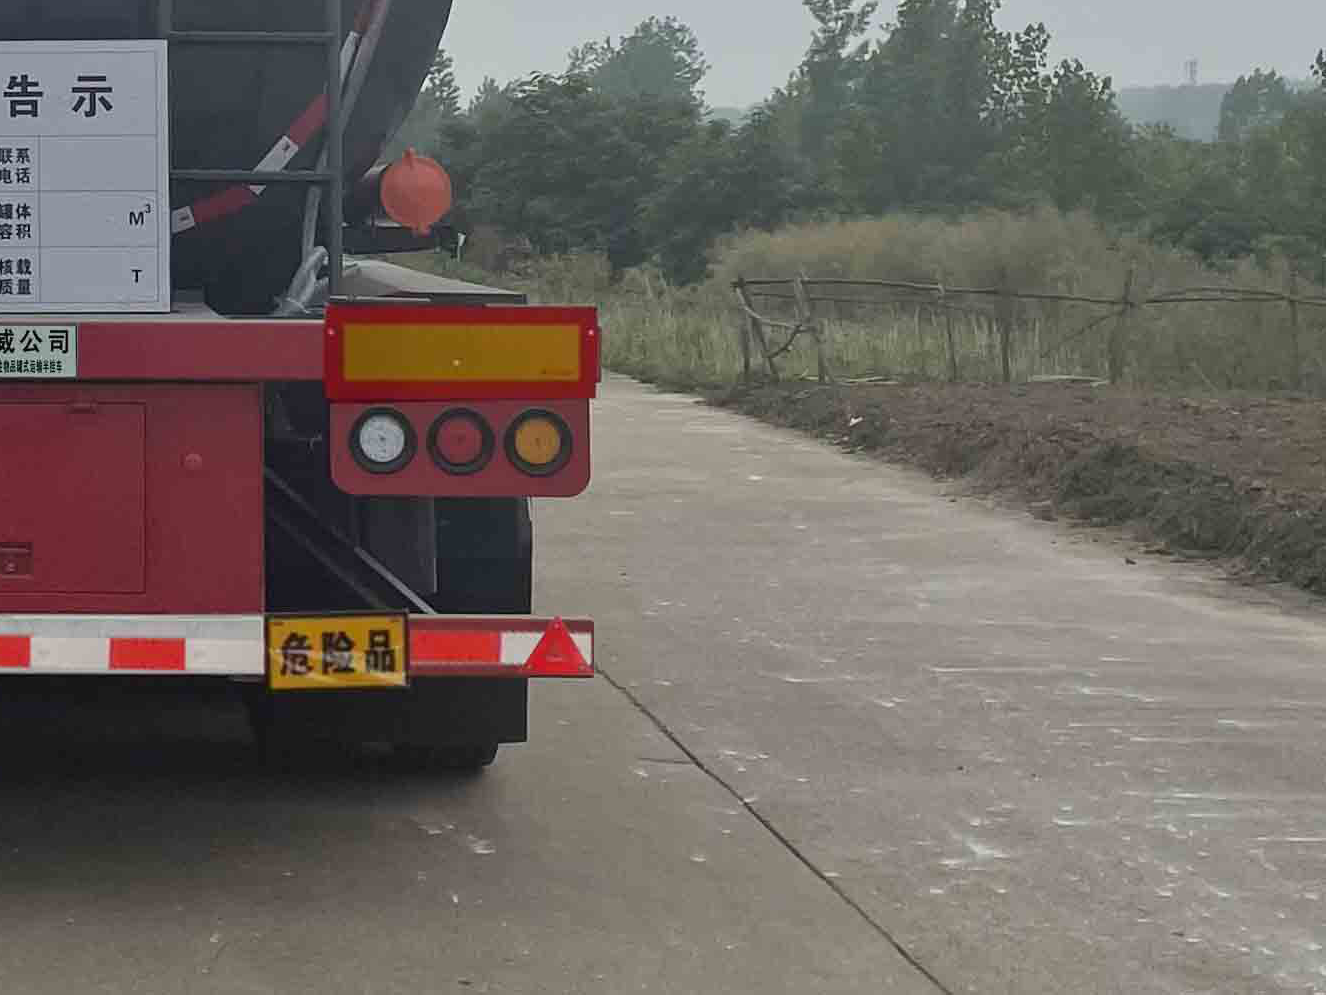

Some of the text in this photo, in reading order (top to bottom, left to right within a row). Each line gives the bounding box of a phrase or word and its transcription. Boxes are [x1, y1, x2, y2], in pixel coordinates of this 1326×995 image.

[131, 269, 143, 283] T
[280, 629, 397, 676] 危险品
